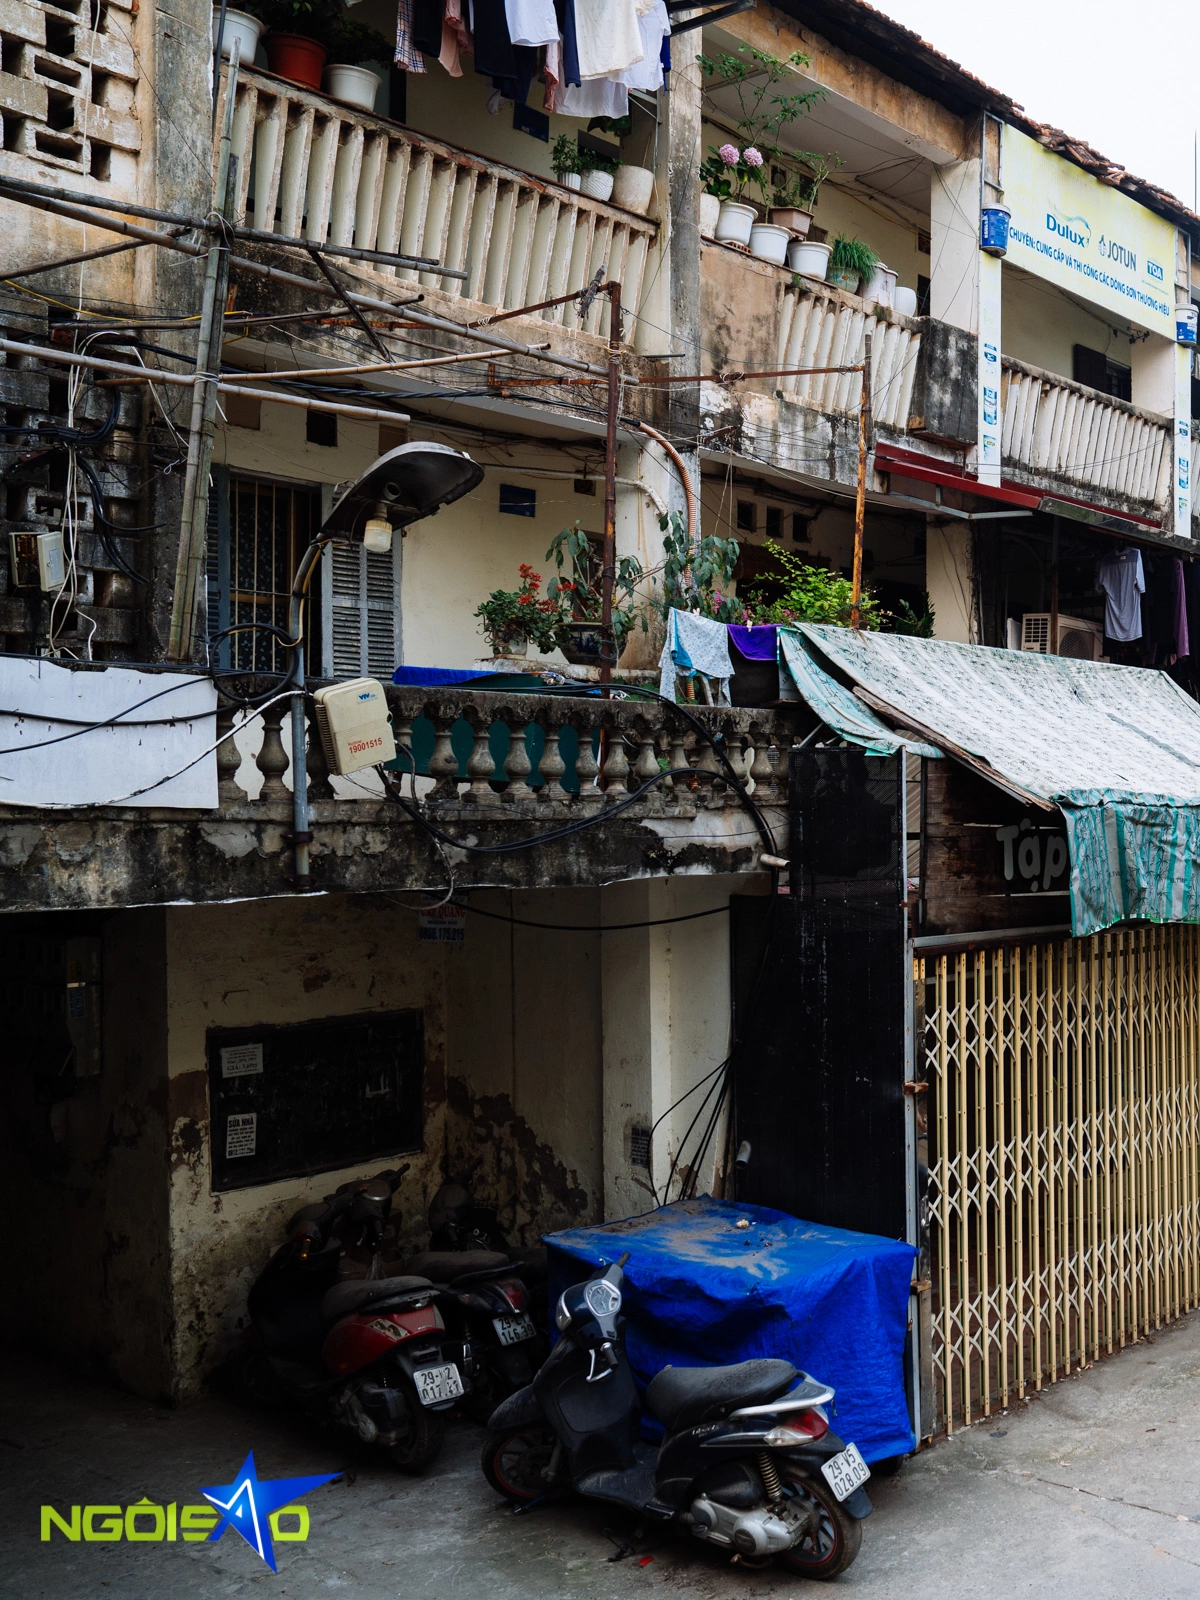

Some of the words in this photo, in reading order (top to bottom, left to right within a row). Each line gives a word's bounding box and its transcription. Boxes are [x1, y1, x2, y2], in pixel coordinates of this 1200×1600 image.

[1046, 213, 1085, 248] Dulux
[1107, 239, 1136, 272] JOTUN
[1148, 261, 1162, 280] TOA
[1036, 240, 1052, 258] CUNG
[1053, 248, 1064, 262] CẤP
[1065, 254, 1072, 268] VÀ
[1073, 258, 1082, 272] THI
[1083, 264, 1098, 280] CÔNG
[1099, 272, 1110, 286] CÁC
[1110, 277, 1126, 294] DÒNG
[1126, 286, 1136, 300] SƠN
[1137, 290, 1158, 310] THƯƠNG
[1158, 302, 1170, 317] HIỆU
[349, 738, 382, 754] 19001515
[438, 905, 466, 920] QUANG
[242, 1116, 254, 1126] NHÀ
[828, 1449, 856, 1479] 29-V5
[834, 1462, 867, 1497] 028.09
